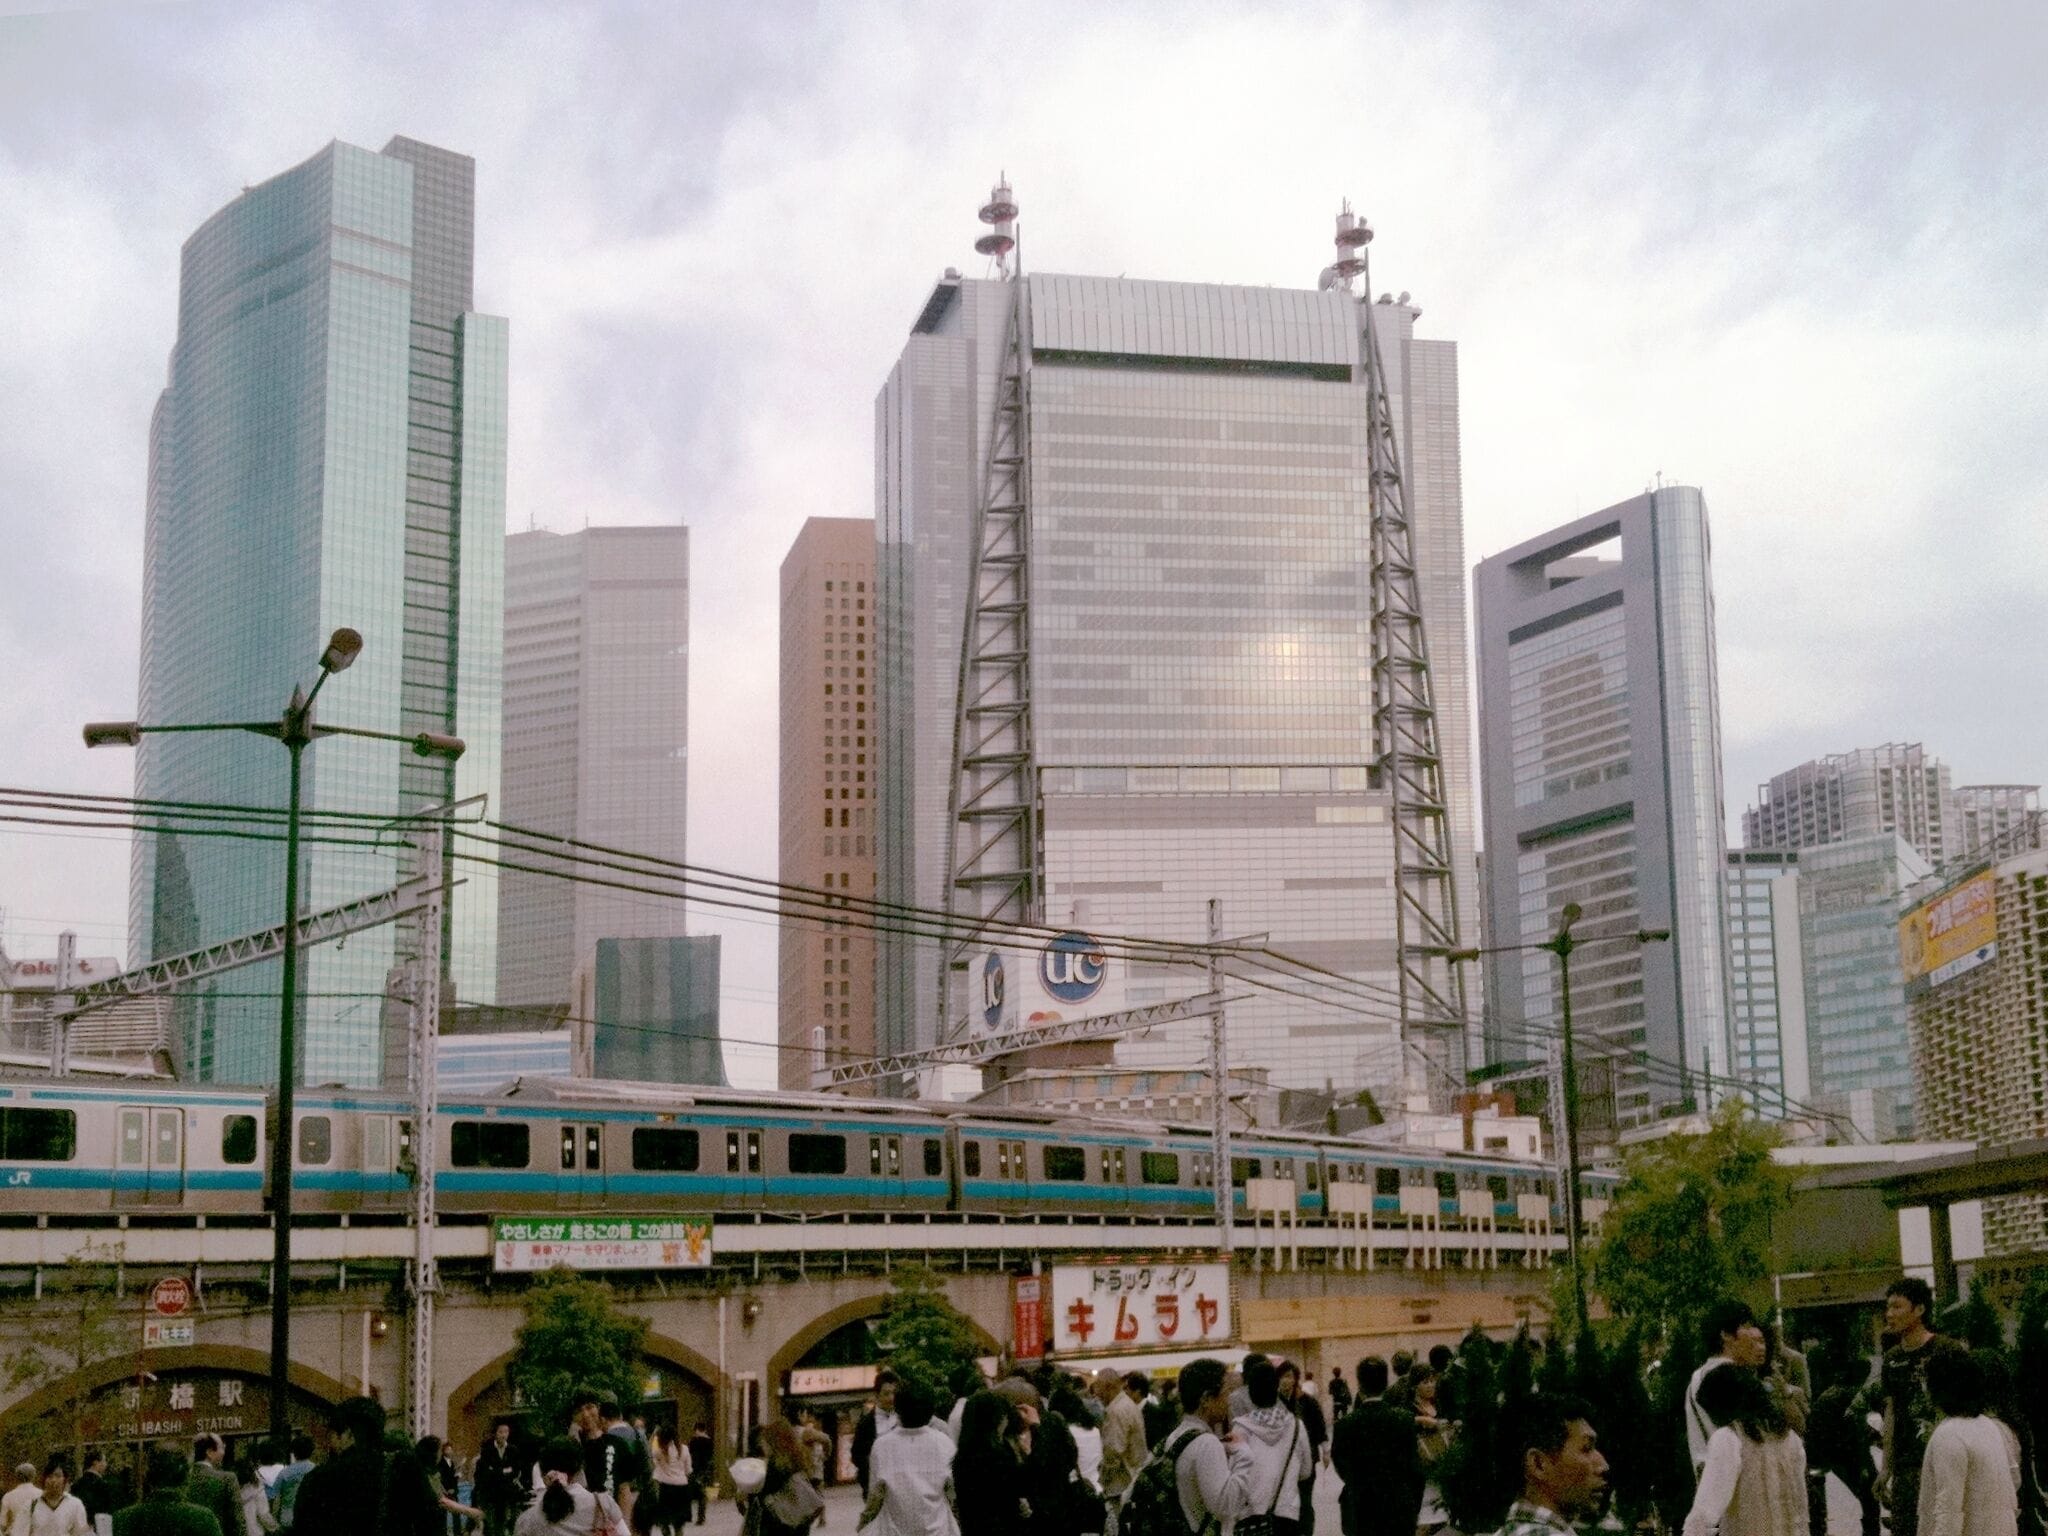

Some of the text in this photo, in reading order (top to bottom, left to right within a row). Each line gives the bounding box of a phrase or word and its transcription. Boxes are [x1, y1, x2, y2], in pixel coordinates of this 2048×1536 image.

[9, 1170, 31, 1185] JR
[1067, 1293, 1218, 1343] キムラヤ
[196, 1416, 242, 1432] STATION
